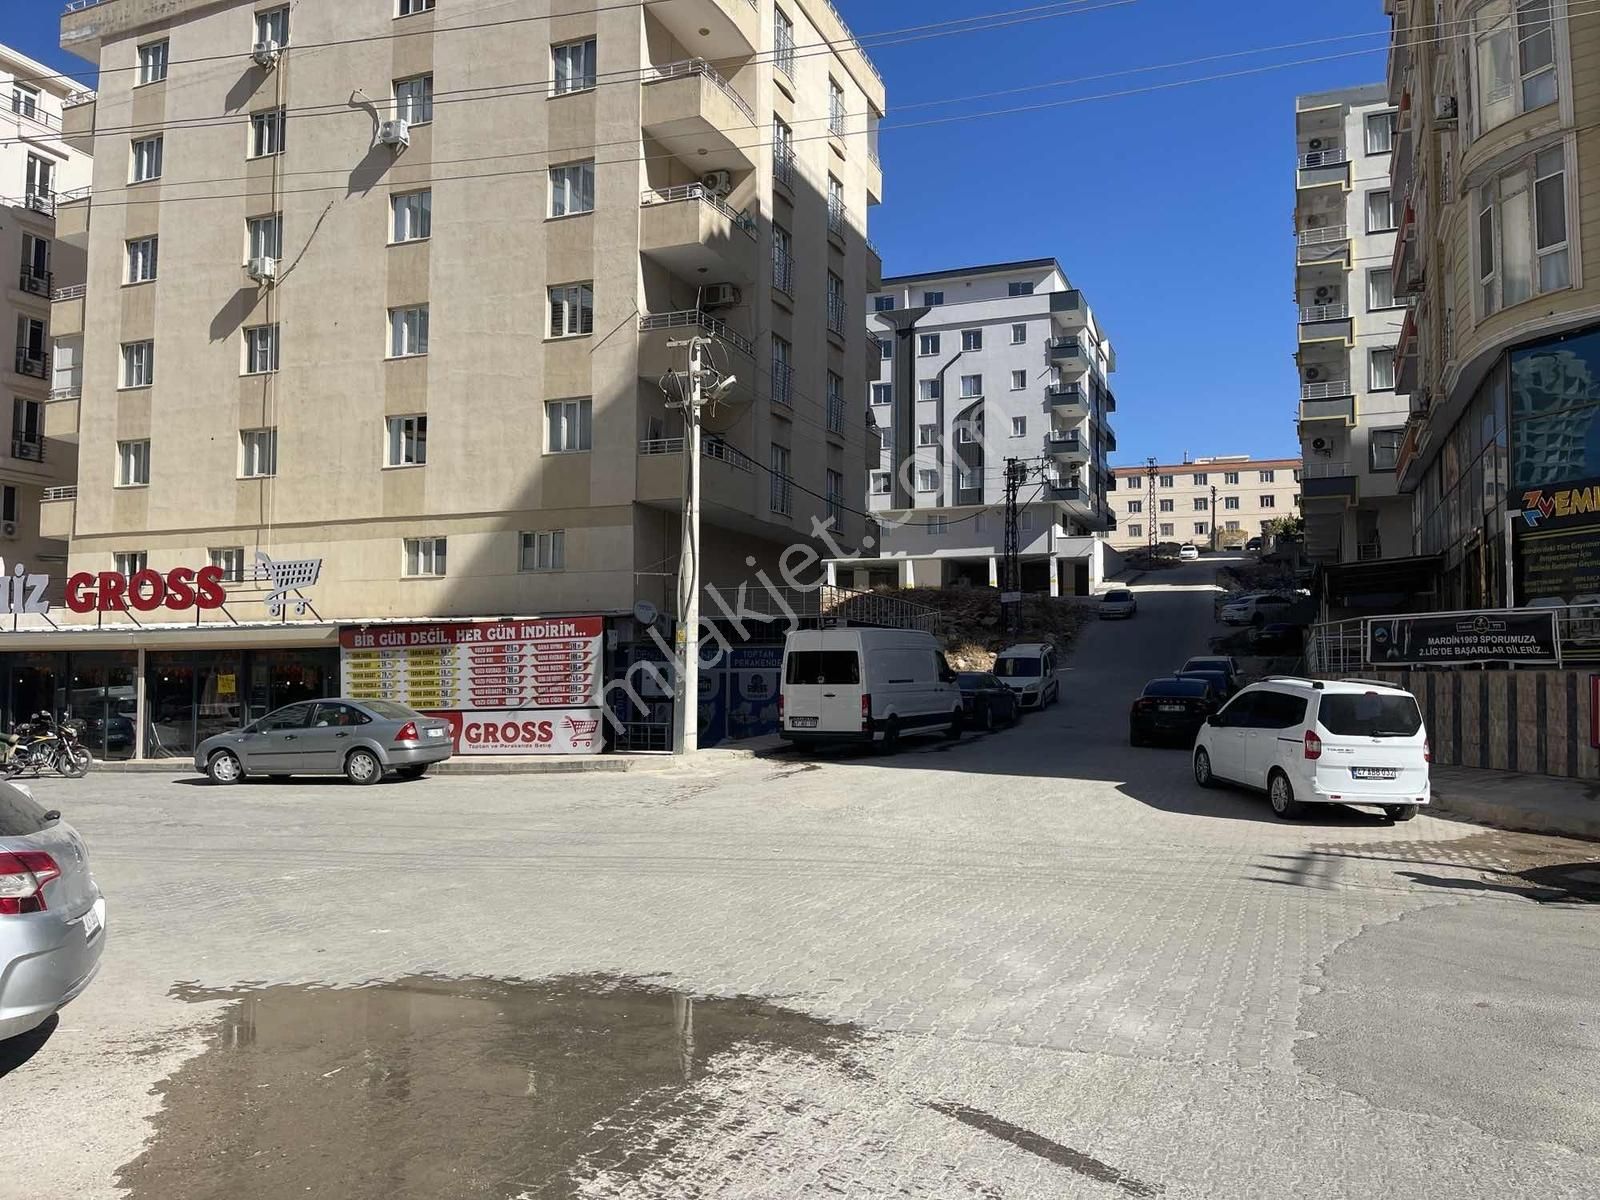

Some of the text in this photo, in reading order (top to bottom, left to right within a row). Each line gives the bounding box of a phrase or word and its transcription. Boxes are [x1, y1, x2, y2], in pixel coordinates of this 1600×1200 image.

[0, 563, 227, 614] İZ GROSS
[354, 620, 587, 647] BİR GÜN DEĞİL, HER GÜN İNDİRİM...
[1479, 634, 1537, 645] SPORUMUZA
[1454, 645, 1505, 657] BAŞARILAR
[464, 720, 554, 744] GROSS
